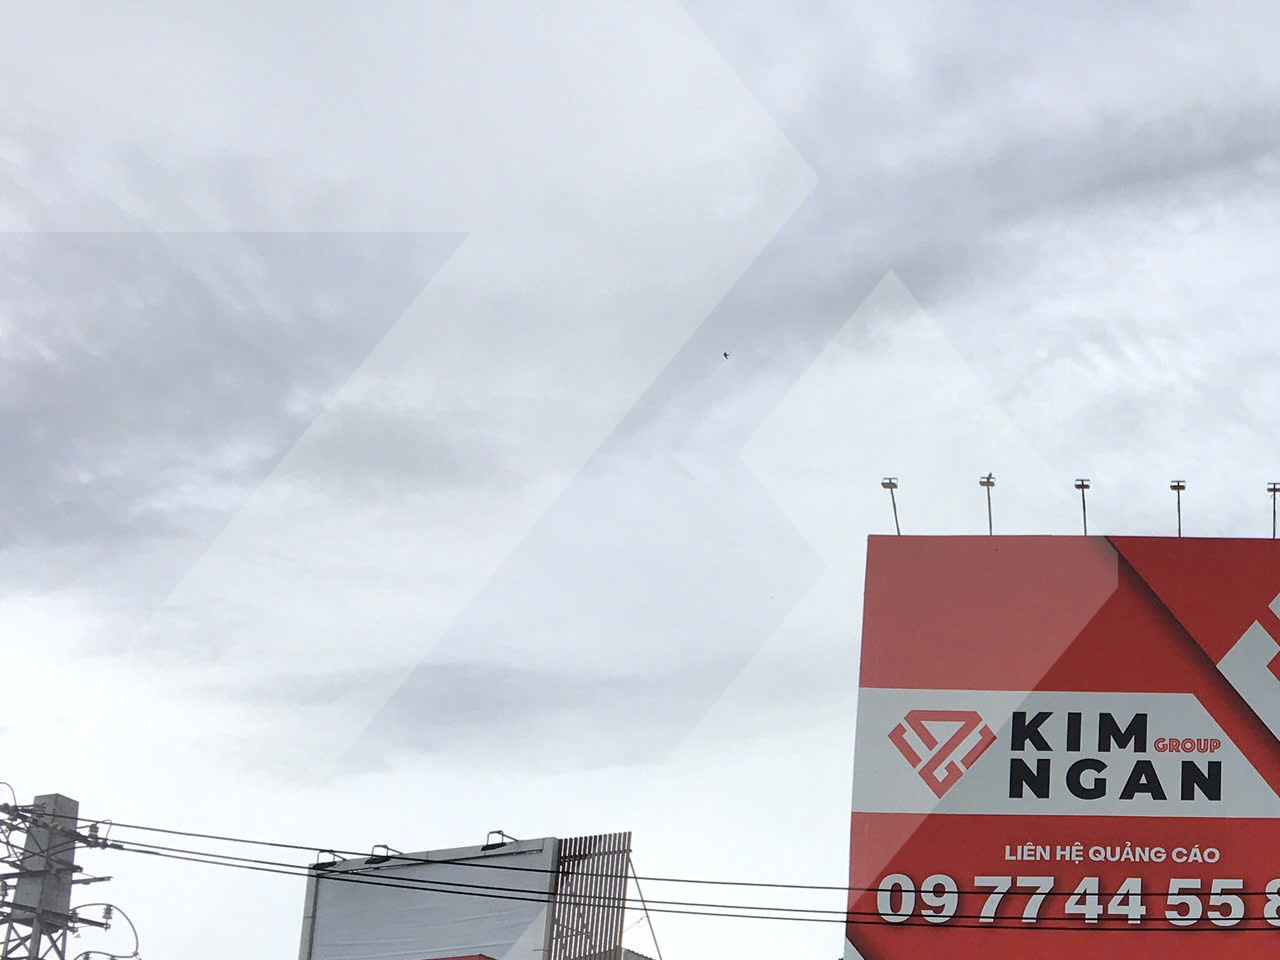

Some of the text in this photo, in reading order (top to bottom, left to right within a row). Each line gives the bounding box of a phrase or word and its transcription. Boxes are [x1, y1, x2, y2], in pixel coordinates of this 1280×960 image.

[1010, 711, 1222, 754] KIM GROUP
[1008, 758, 1222, 802] NGAN
[1004, 841, 1220, 864] LIÊN HỆ QUẢNG CÁO
[876, 873, 960, 924] 09
[974, 875, 1056, 924] 77
[1064, 876, 1147, 925] 44
[1164, 878, 1245, 927] 55
